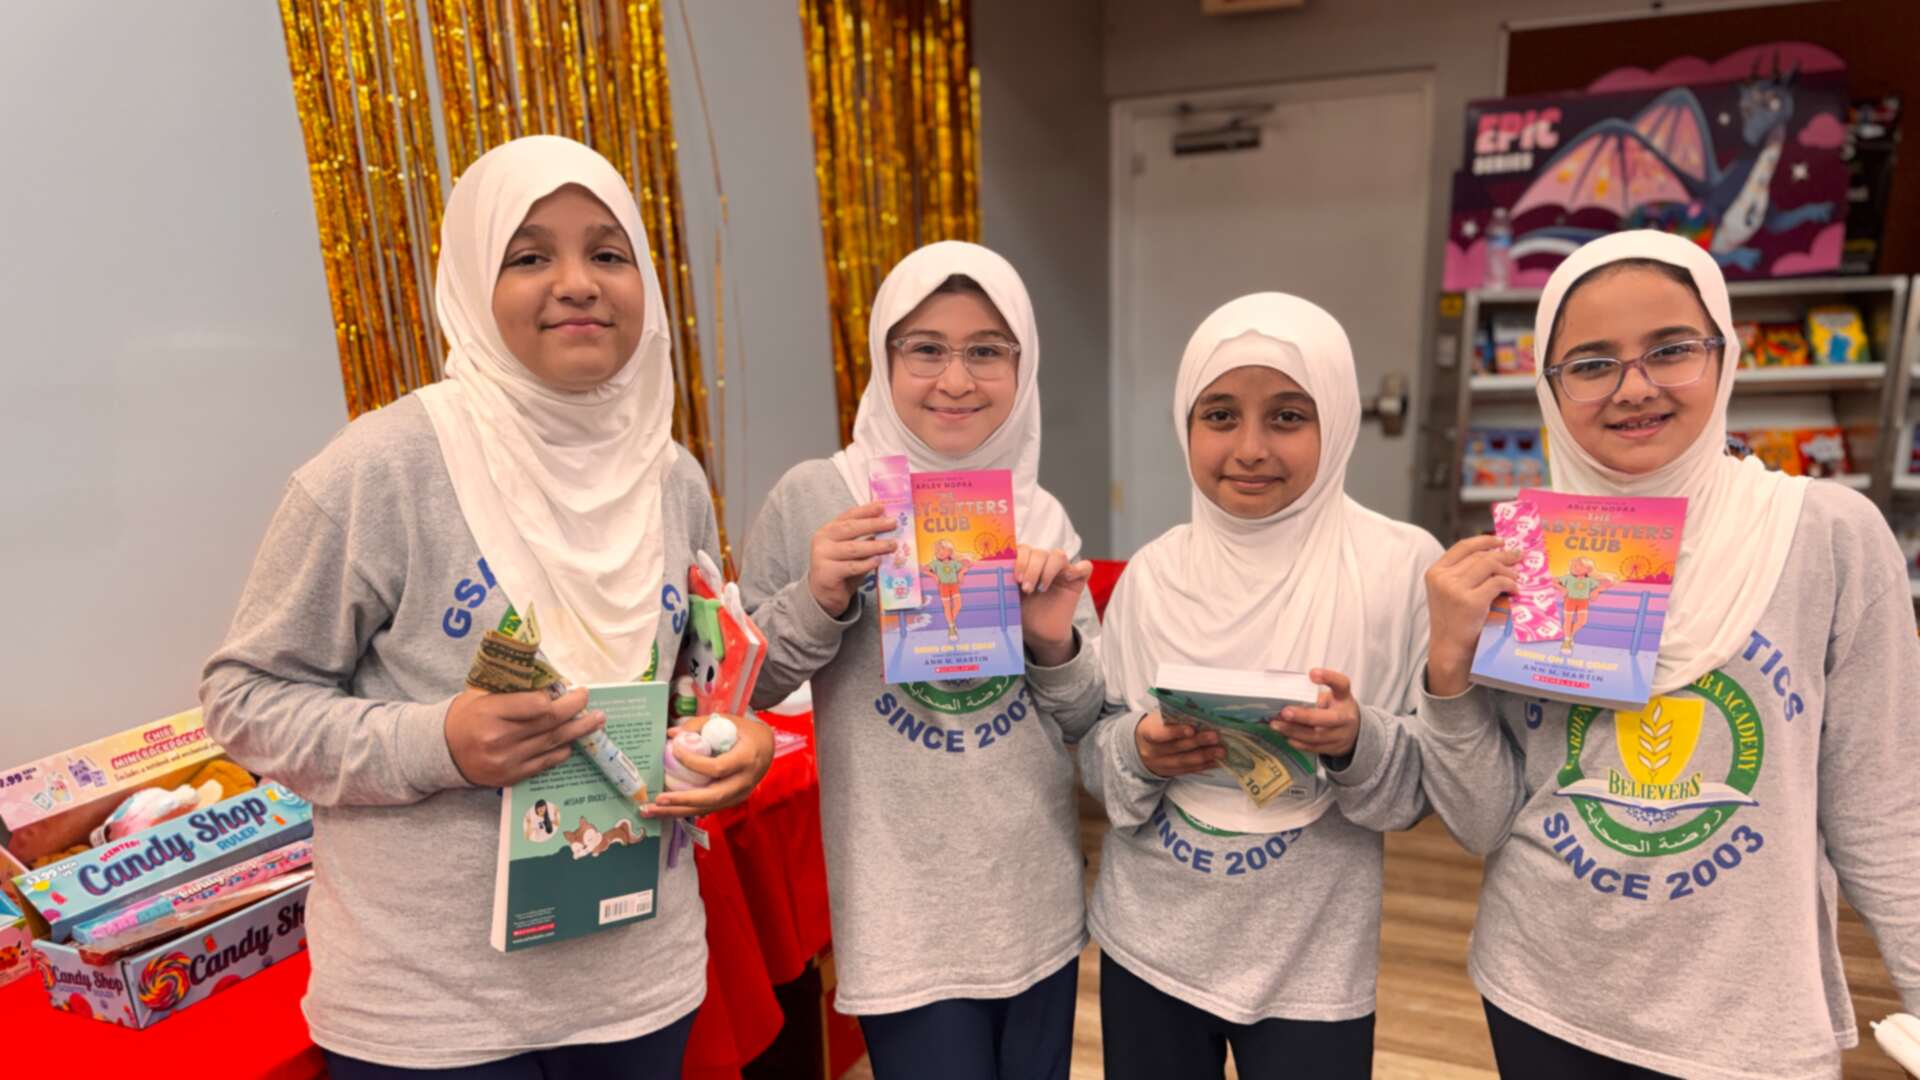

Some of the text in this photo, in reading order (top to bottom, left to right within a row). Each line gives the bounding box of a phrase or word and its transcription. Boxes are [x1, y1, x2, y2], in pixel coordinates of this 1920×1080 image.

[1475, 107, 1562, 154] EPIC
[924, 516, 970, 533] CLUB
[1564, 535, 1621, 553] CLUB
[1742, 629, 1804, 722] TICS
[875, 692, 965, 752] SINCE
[1608, 768, 1702, 801] BELIEVERS
[78, 832, 194, 896] Candy
[188, 797, 267, 843] Shop
[216, 826, 259, 851] RULER
[1543, 812, 1764, 900] SINCE 2003
[189, 925, 273, 986] Candy
[52, 965, 92, 992] Candy
[92, 970, 124, 996] Shop
